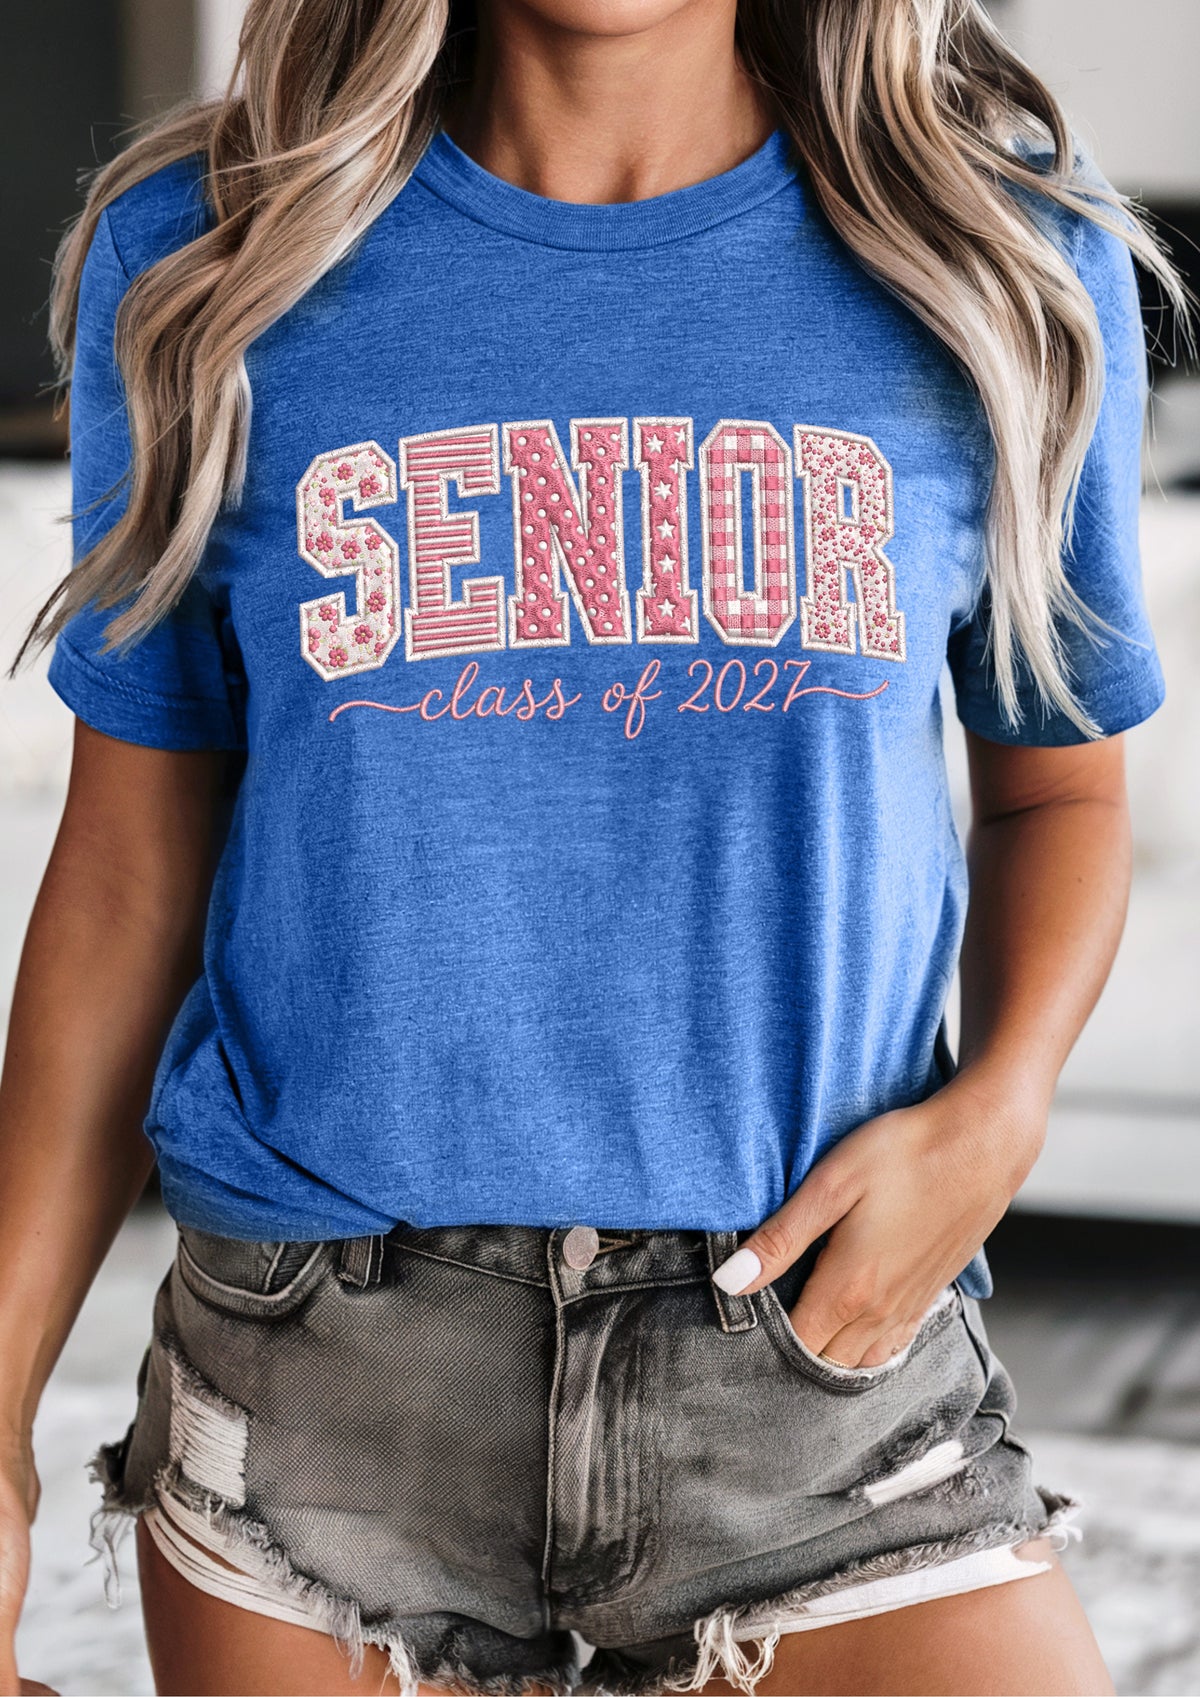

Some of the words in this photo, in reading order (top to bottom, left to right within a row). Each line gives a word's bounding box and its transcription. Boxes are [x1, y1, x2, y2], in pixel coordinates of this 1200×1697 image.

[296, 417, 906, 682] SENIOR
[329, 661, 582, 722] class
[601, 659, 662, 740] of
[677, 659, 889, 713] 2027
